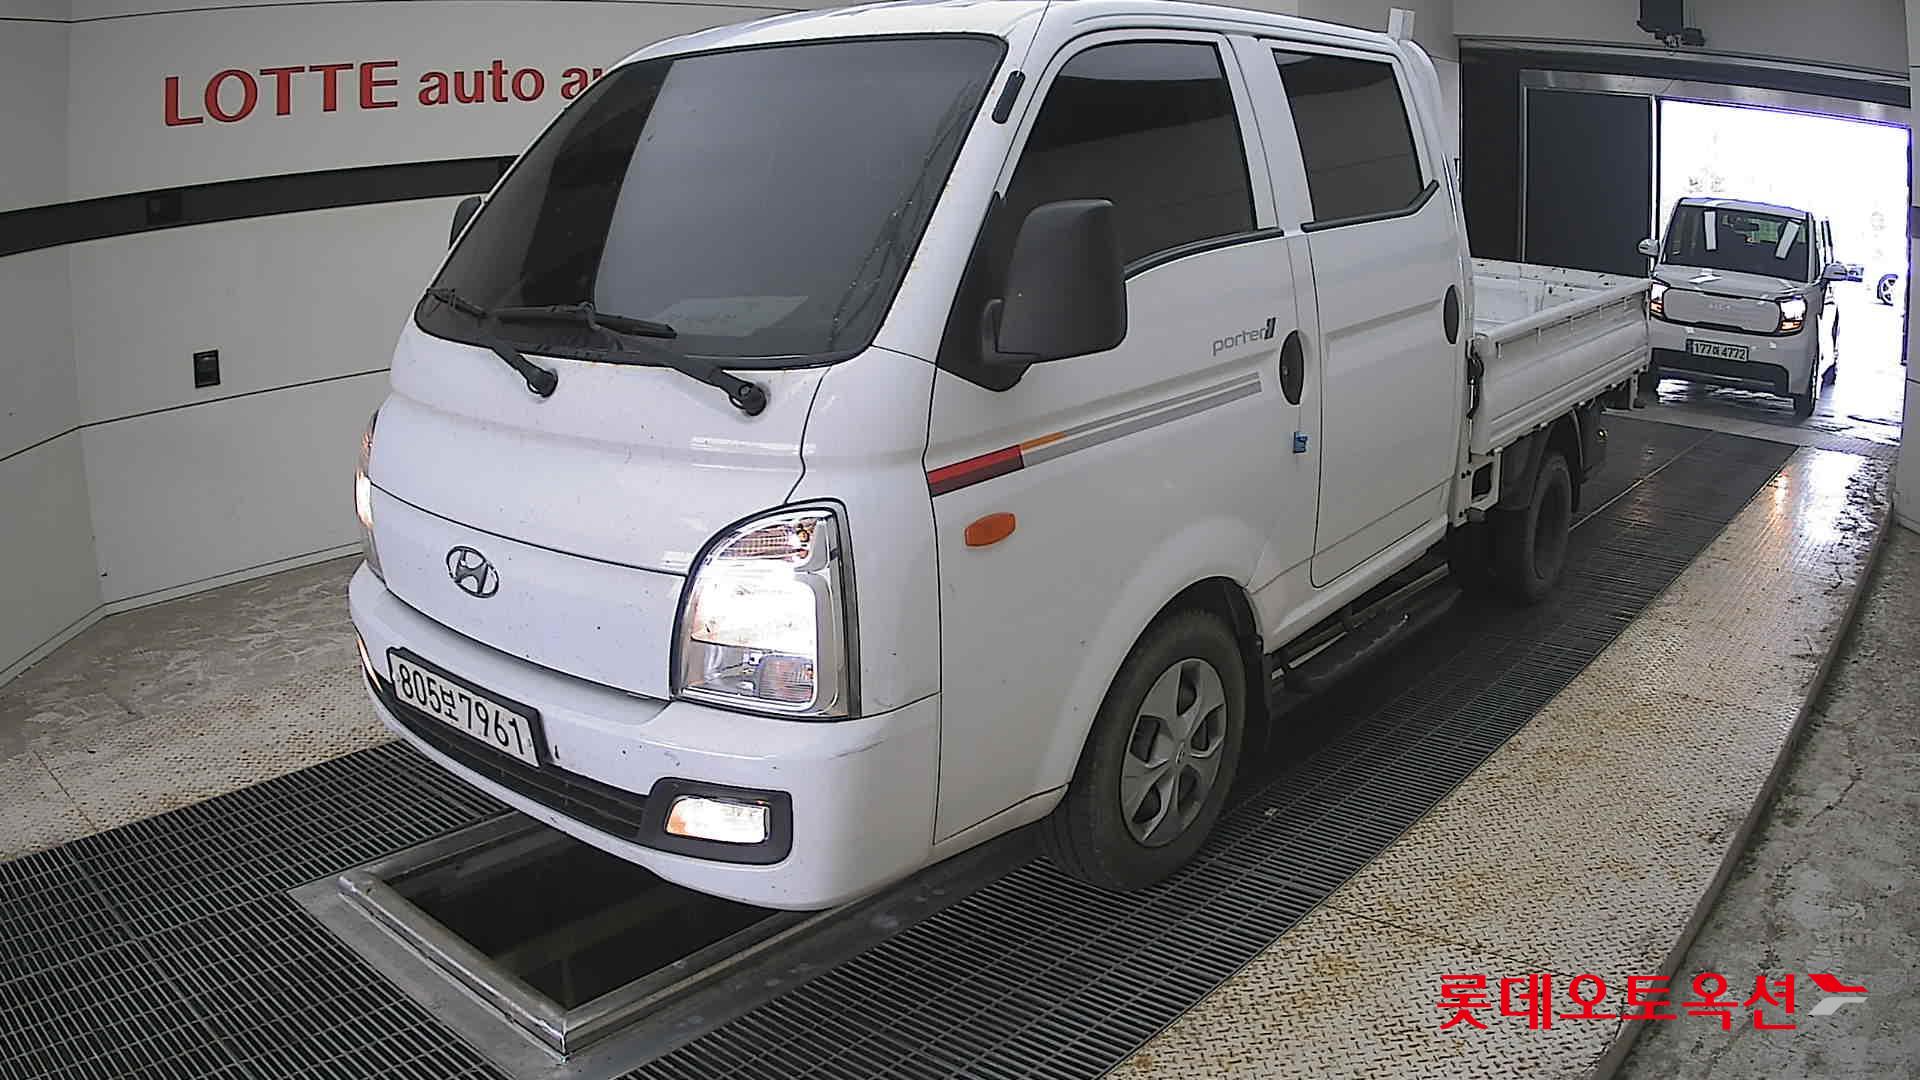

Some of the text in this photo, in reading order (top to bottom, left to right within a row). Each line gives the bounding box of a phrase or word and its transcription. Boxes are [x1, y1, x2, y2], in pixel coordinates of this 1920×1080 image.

[165, 61, 399, 127] LOTTE
[418, 59, 546, 107] auto
[1213, 327, 1266, 357] porter
